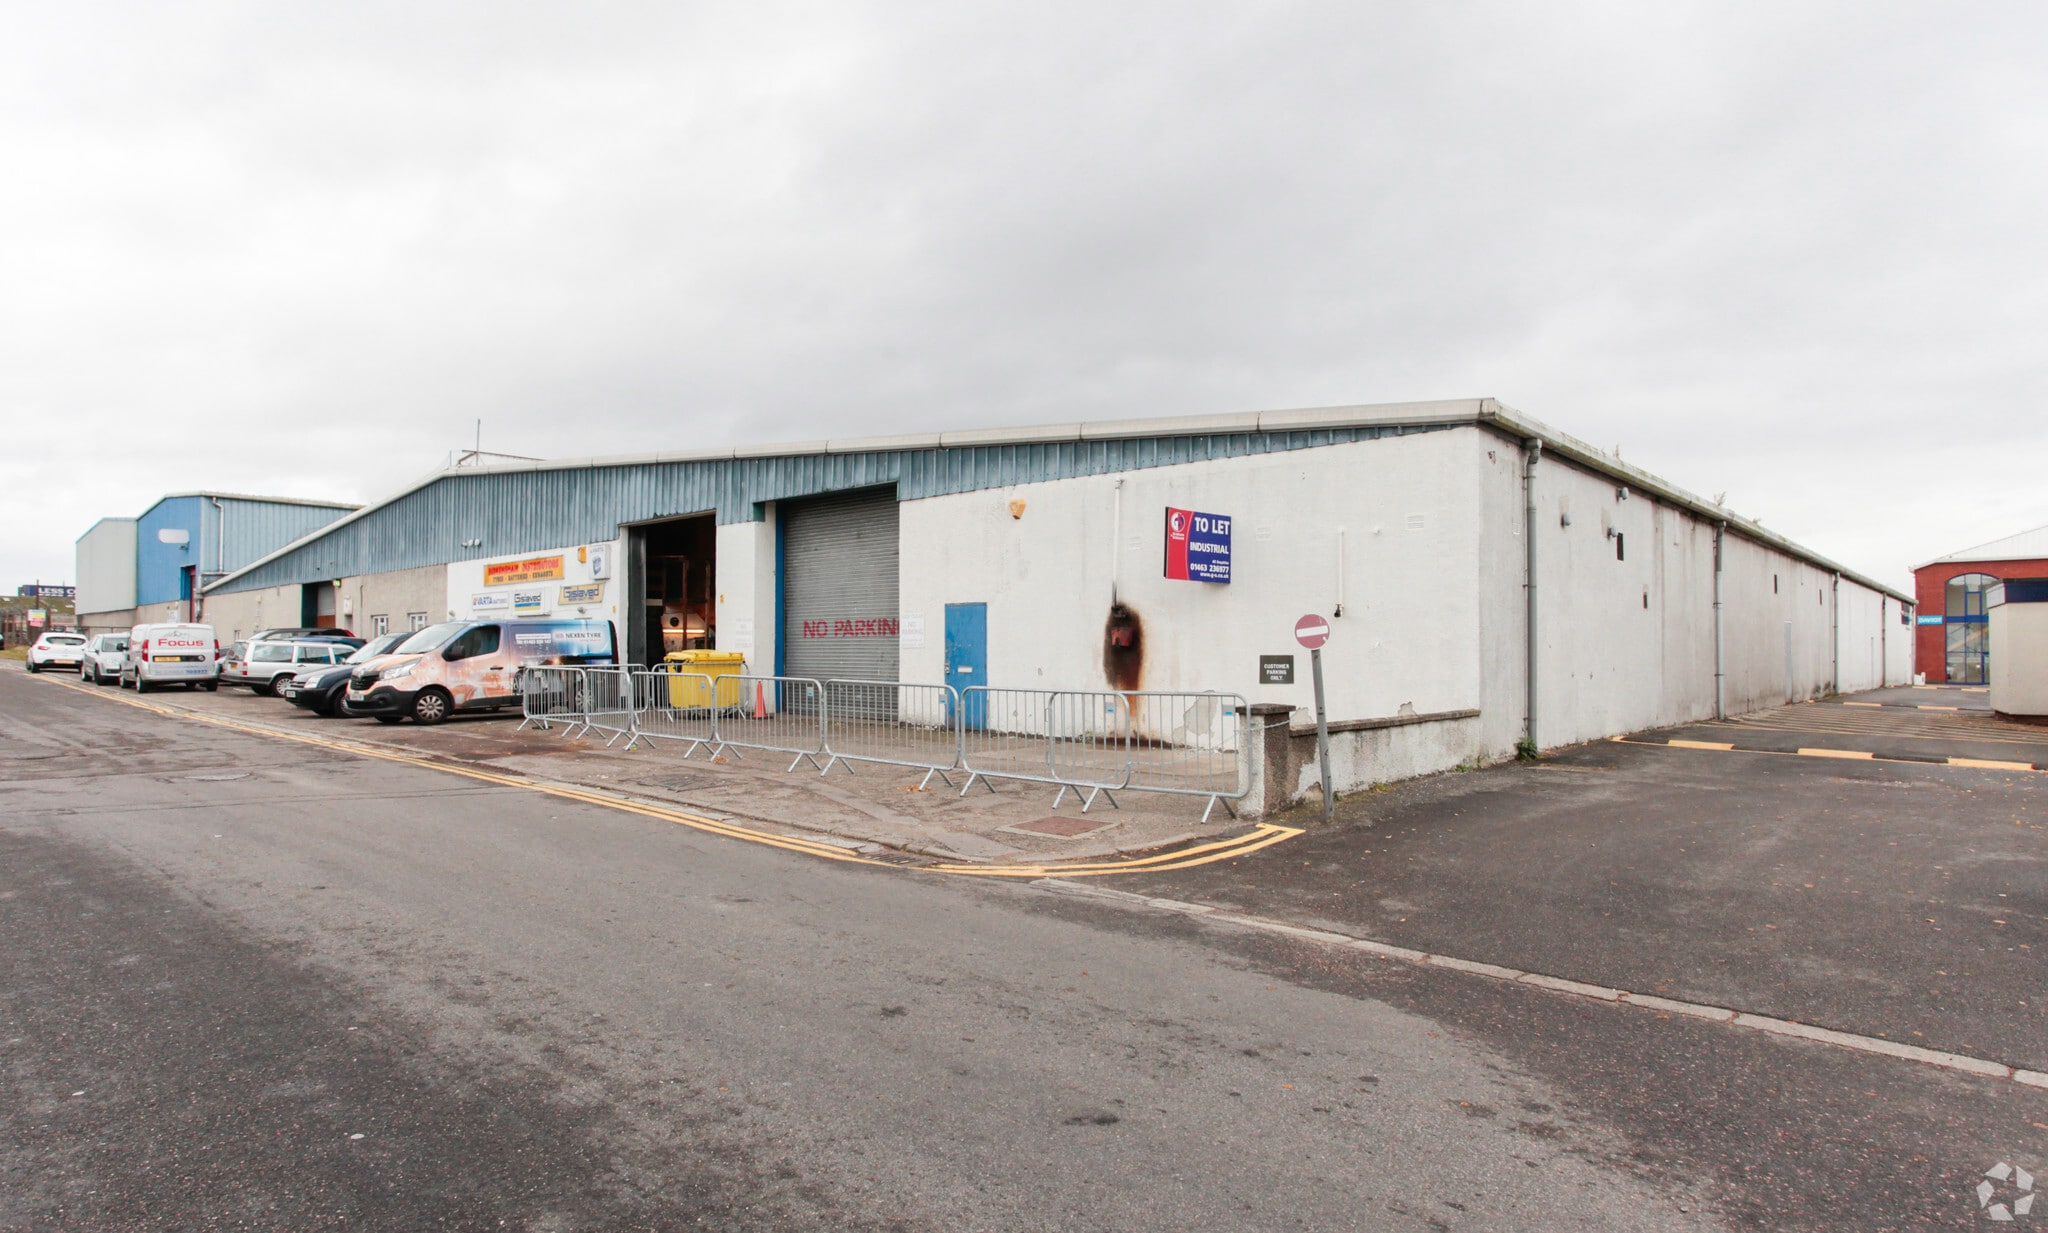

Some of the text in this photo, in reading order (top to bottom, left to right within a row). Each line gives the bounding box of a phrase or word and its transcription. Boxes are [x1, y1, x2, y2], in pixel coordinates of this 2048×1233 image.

[1194, 517, 1230, 535] TO LET
[1189, 541, 1229, 555] INDUSTRIAL
[1190, 563, 1208, 572] 01463
[803, 618, 899, 638] NO PARKIN
